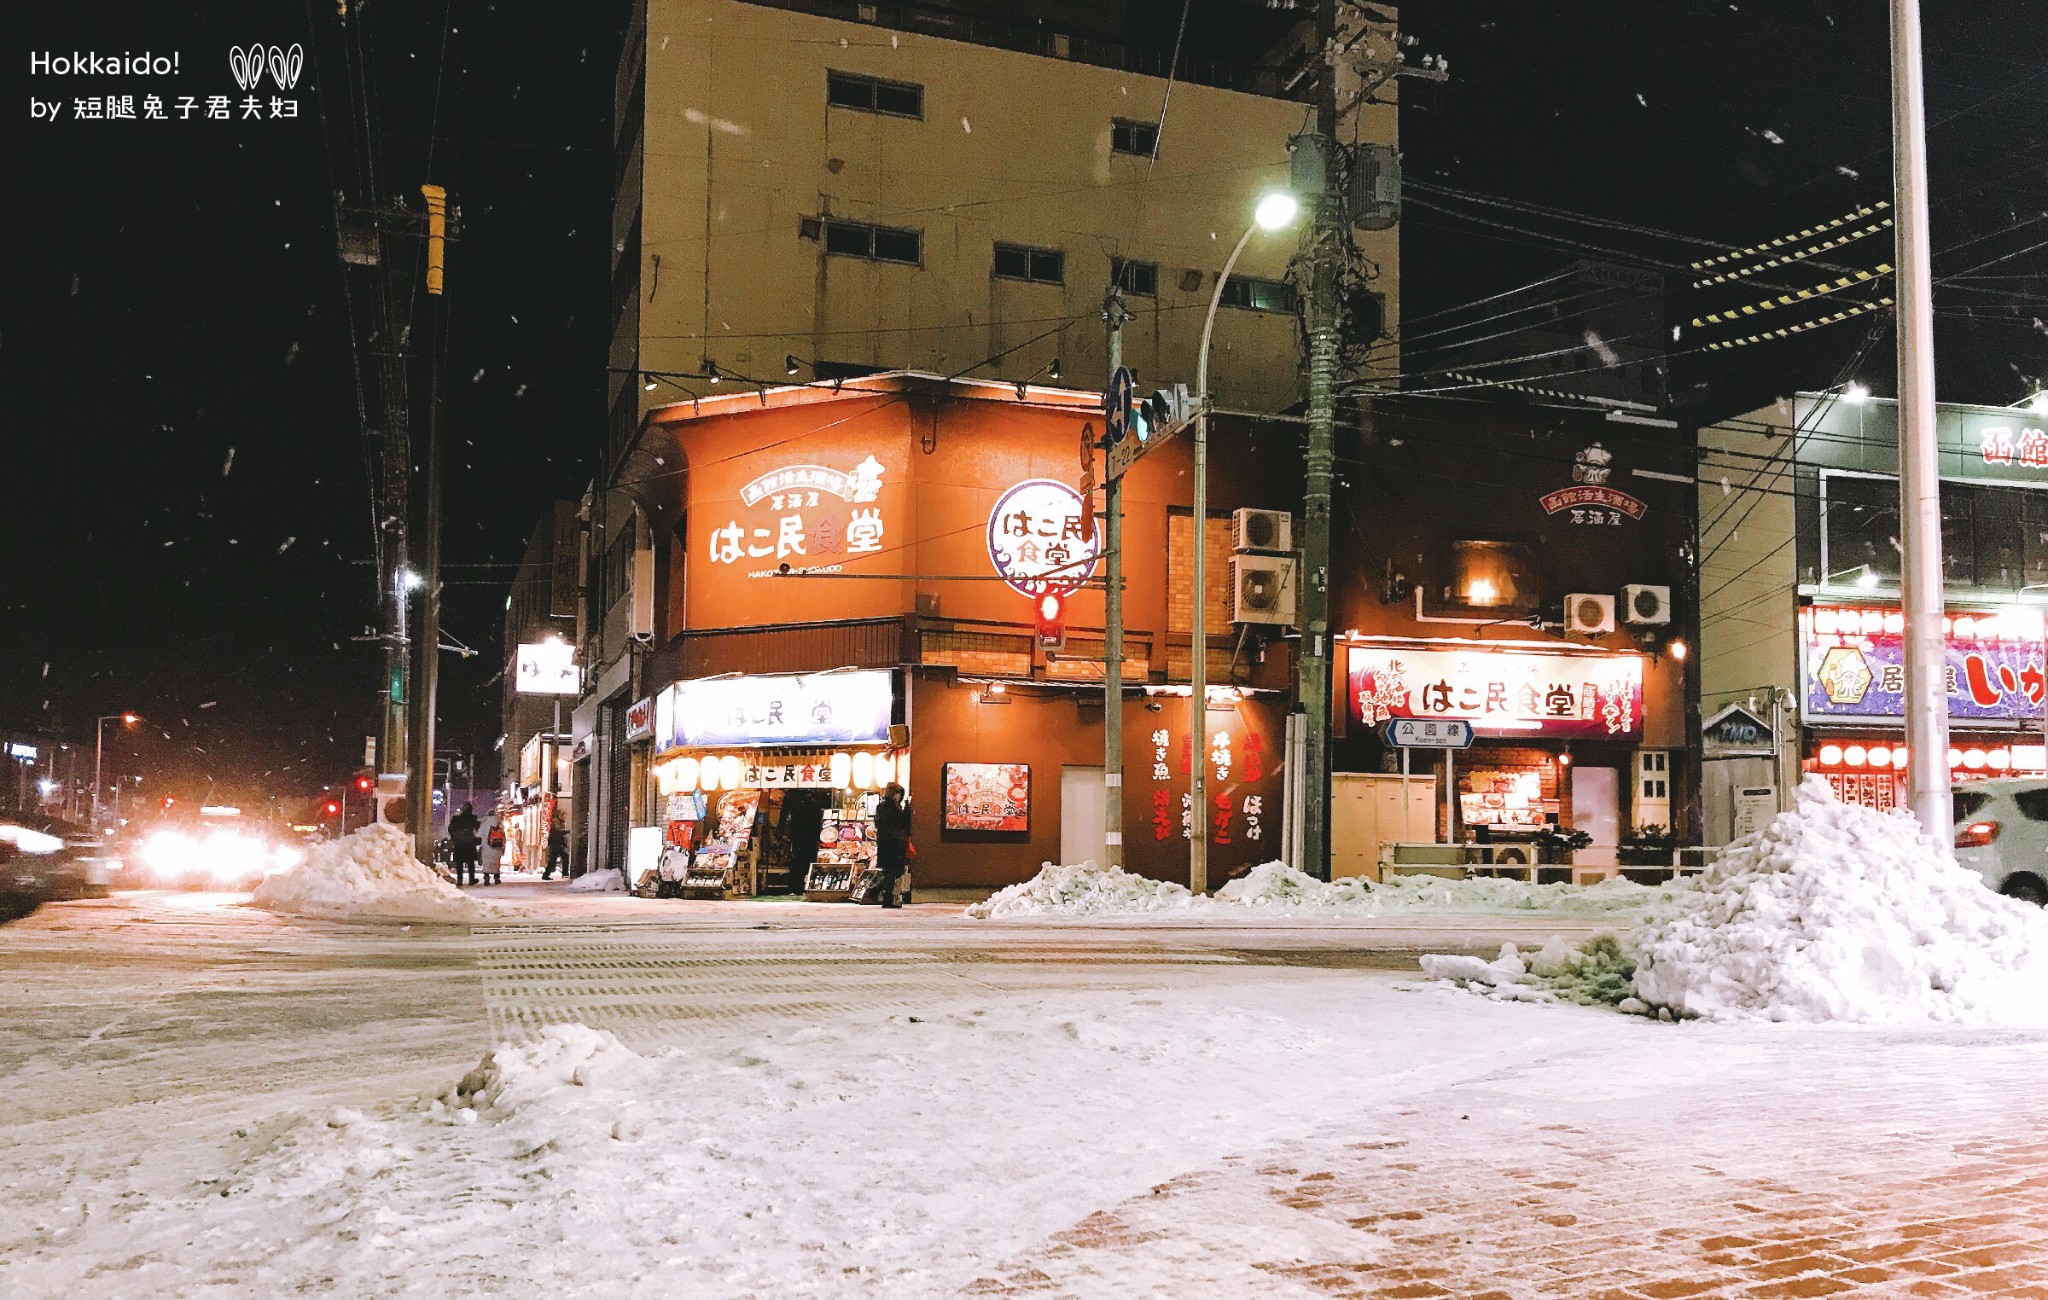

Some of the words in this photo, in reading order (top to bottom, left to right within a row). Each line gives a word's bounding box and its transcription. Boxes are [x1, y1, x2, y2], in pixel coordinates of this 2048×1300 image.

[1981, 427, 2048, 468] 函館
[1548, 490, 1639, 514] 函館活生酒場
[1571, 509, 1622, 526] 居酒屋
[709, 507, 884, 564] はこ民食堂
[1017, 540, 1070, 566] 食堂
[1422, 678, 1575, 717] はこ民食堂
[1402, 722, 1459, 737] 公園線
[1151, 728, 1171, 781] 焼き魚
[744, 762, 832, 783] はこ民食堂
[1243, 795, 1263, 840] ほっけ
